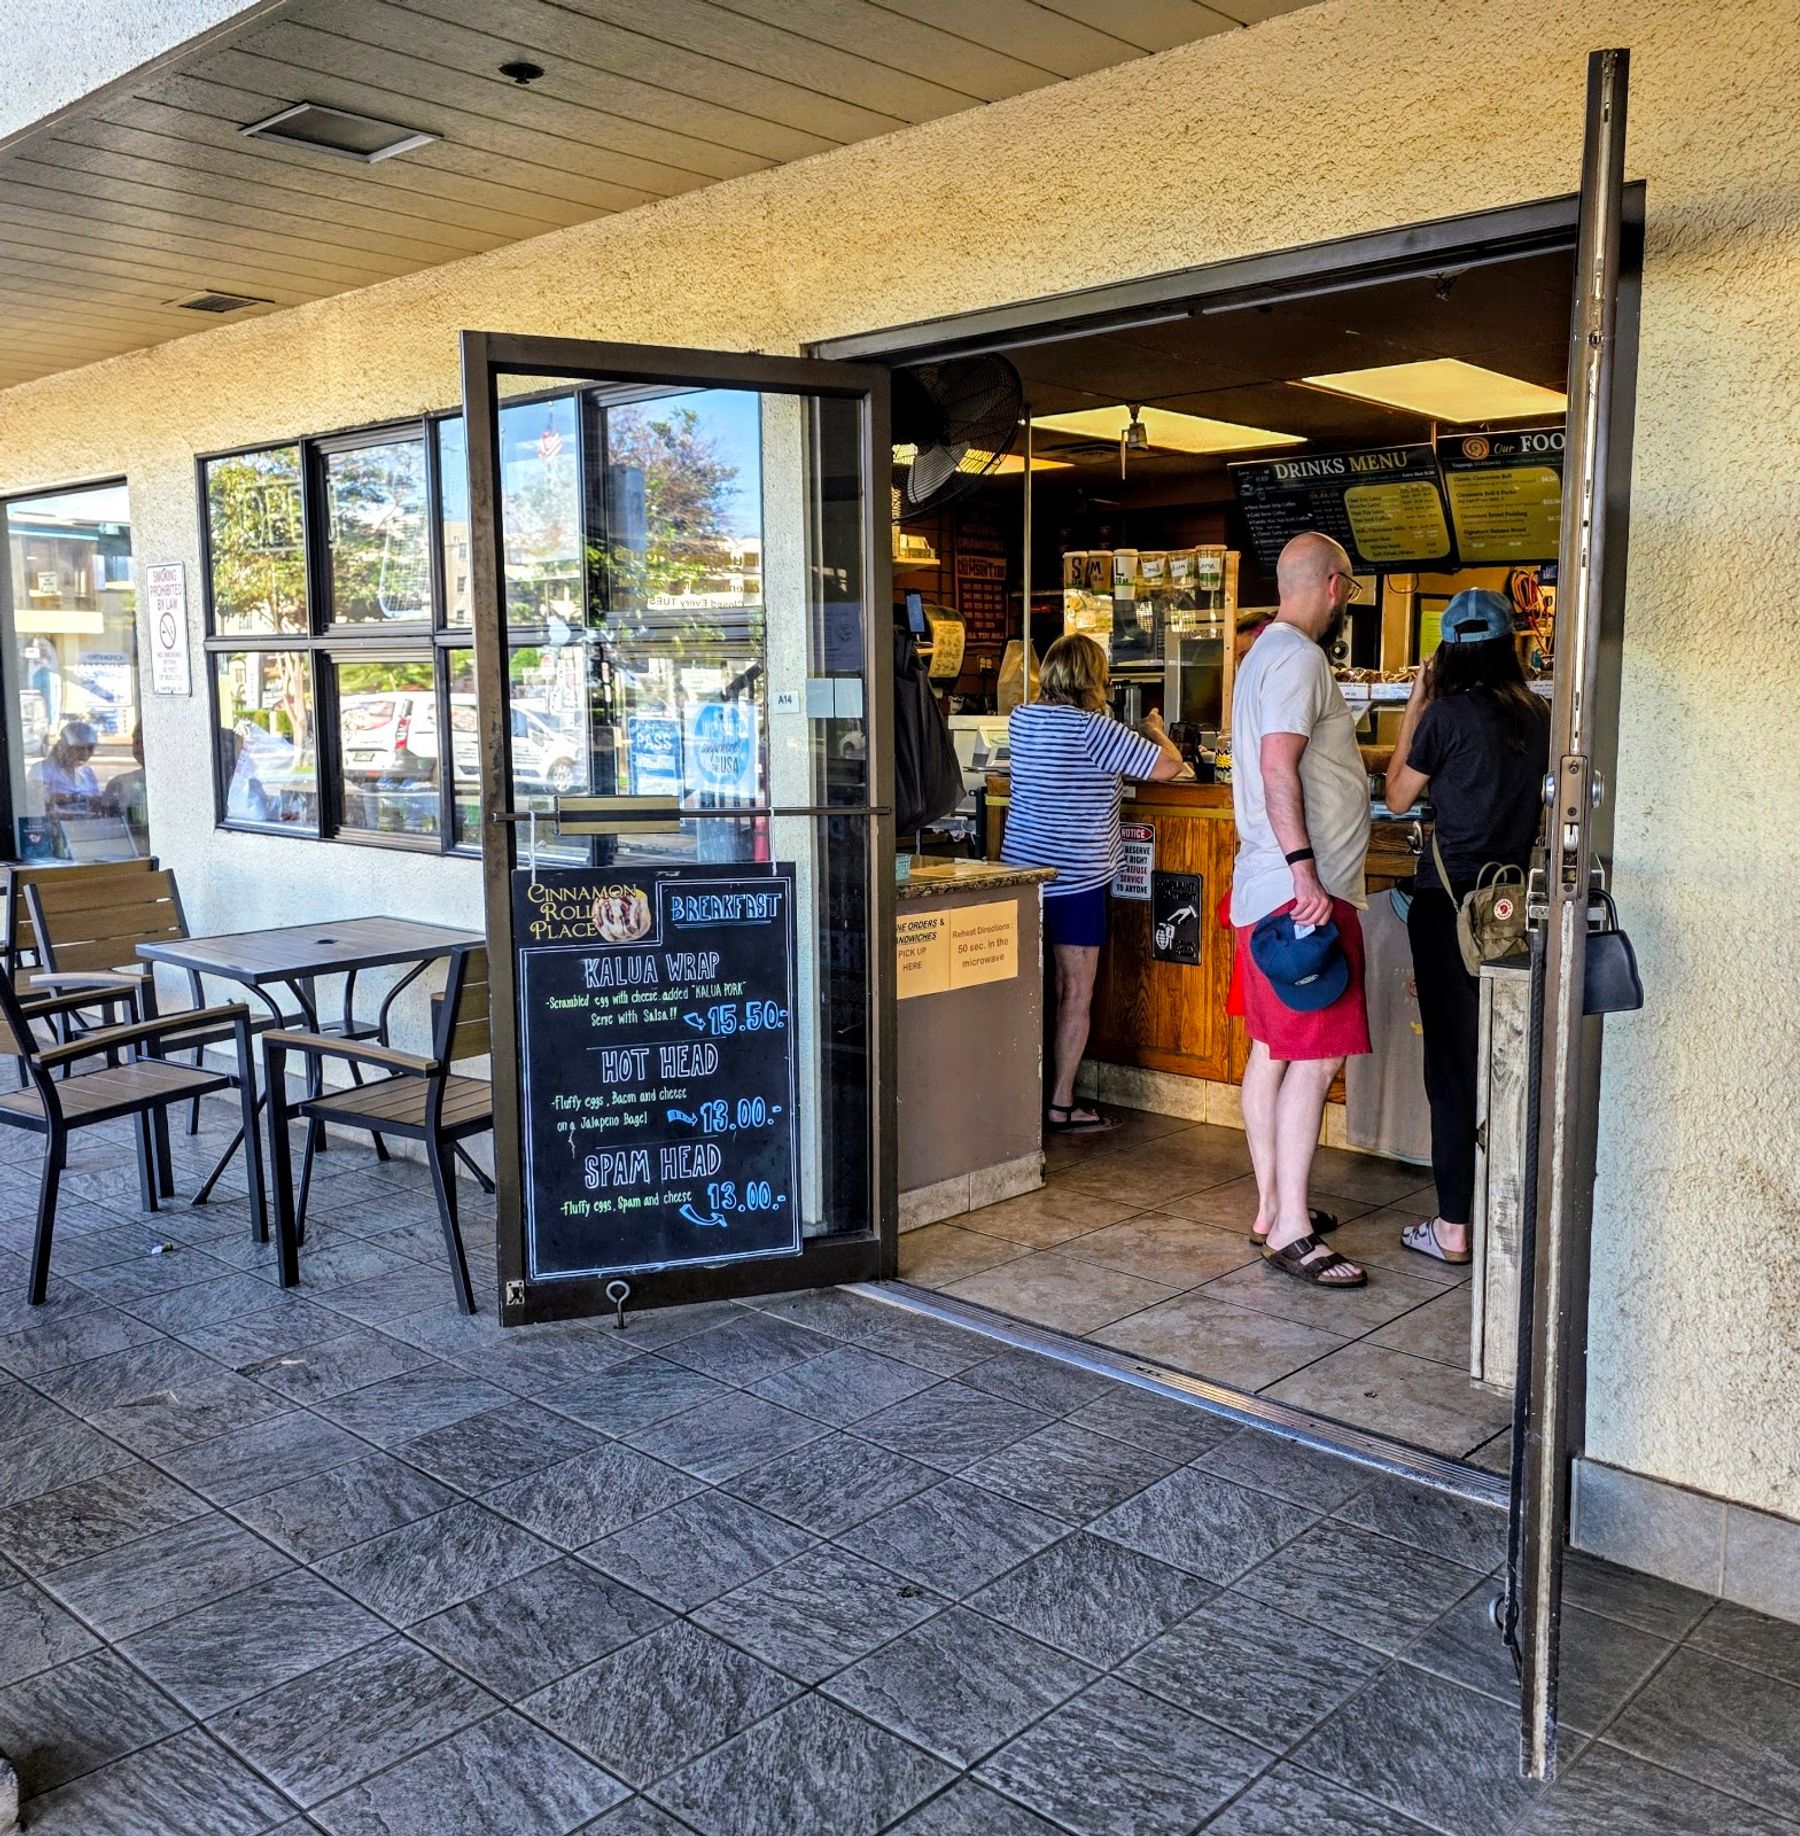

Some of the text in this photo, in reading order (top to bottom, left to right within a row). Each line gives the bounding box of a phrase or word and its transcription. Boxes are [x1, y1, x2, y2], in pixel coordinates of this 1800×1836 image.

[1274, 451, 1407, 479] DRINKS MENU
[153, 569, 177, 582] SMOKING
[1115, 558, 1124, 576] L
[150, 583, 182, 597] PROHIBITED
[157, 598, 178, 611] BY LAW
[778, 694, 792, 705] A14
[636, 731, 672, 751] PASS
[721, 756, 739, 775] USA
[1121, 828, 1145, 839] NOTICE
[1124, 845, 1151, 855] RESERVE
[1129, 855, 1148, 865] RIGHT
[1120, 875, 1144, 884] SERVICE
[527, 883, 637, 903] CINNAMON
[1116, 883, 1148, 894] TO ANYONE
[540, 902, 595, 922] ROLL
[671, 892, 783, 922] BREAKFAST
[529, 921, 598, 941] PLACE
[907, 919, 938, 931] ORDERS
[939, 918, 945, 926] &
[952, 927, 977, 939] Reheat
[898, 946, 927, 958] PICK UP
[958, 938, 1009, 954] 50 sec. in the
[903, 961, 922, 972] HERE
[962, 953, 1005, 968] microwave
[584, 952, 720, 988] KALUA WRAP
[594, 995, 609, 1008] egg
[612, 991, 629, 1005] with
[591, 1011, 614, 1027] Serve
[618, 1009, 639, 1025] with
[602, 1044, 719, 1083] HOT HEAD
[612, 1091, 637, 1105] Bacon
[639, 1088, 656, 1102] and
[659, 1086, 687, 1101] cheese
[557, 1111, 648, 1132] on a Jalapeno Bagel
[584, 1144, 722, 1189] SPAM HEAD
[617, 1195, 642, 1214] Spam
[643, 1193, 660, 1206] and
[663, 1190, 692, 1204] cheese
